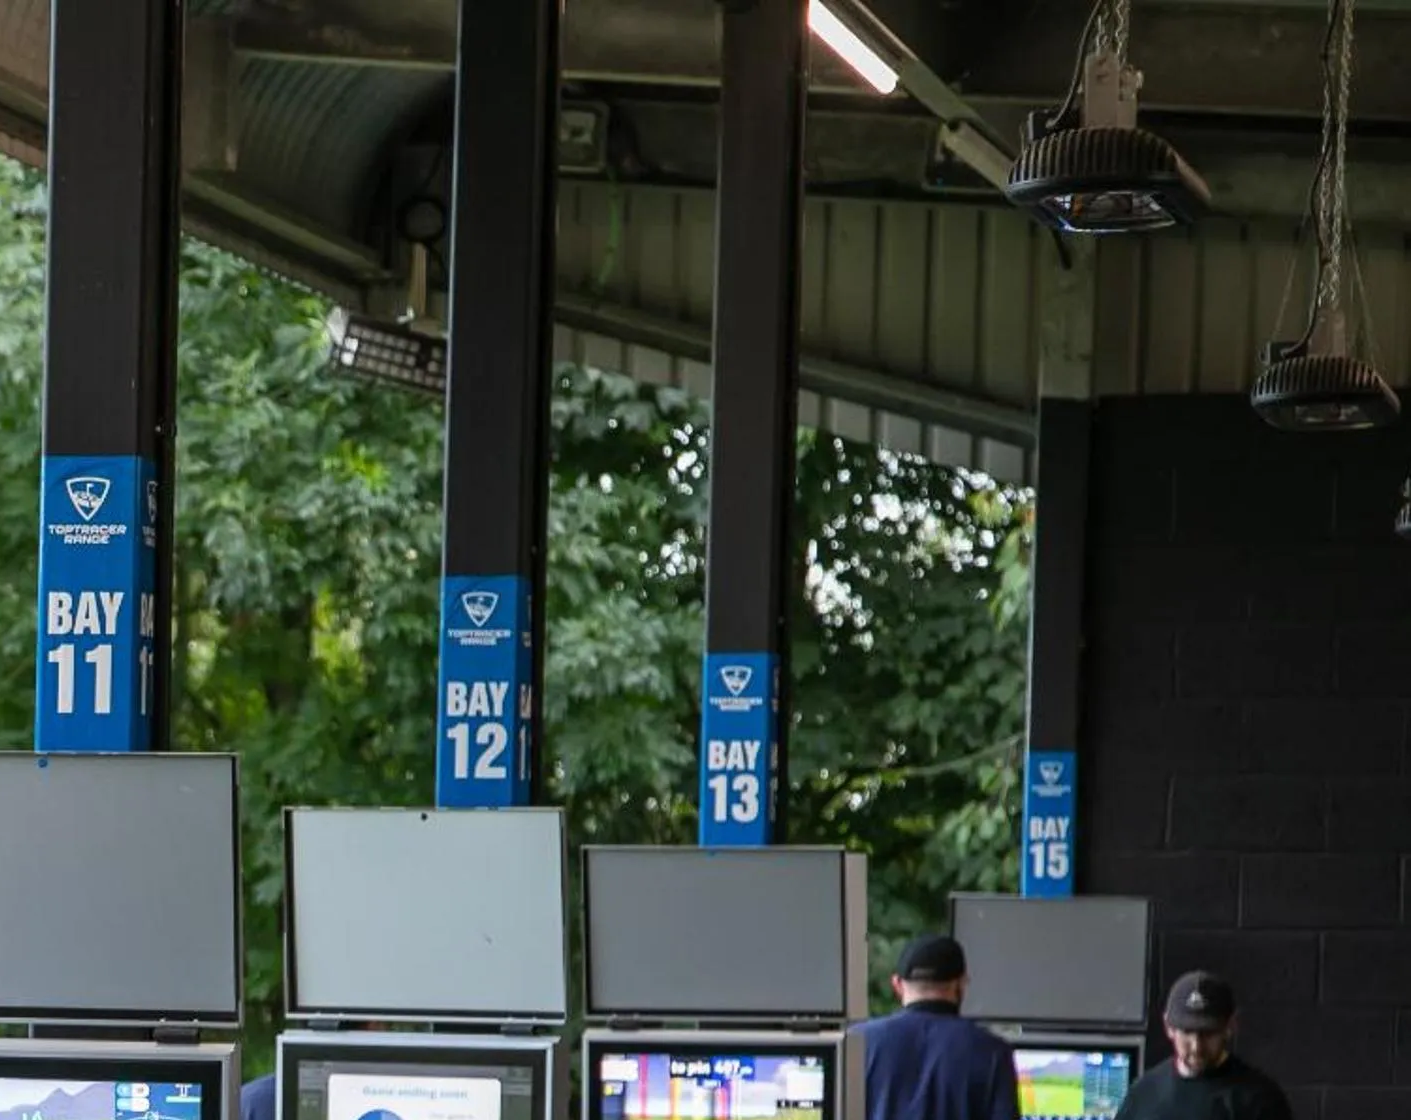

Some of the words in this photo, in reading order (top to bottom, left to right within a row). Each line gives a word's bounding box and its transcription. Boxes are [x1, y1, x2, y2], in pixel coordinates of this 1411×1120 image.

[48, 524, 127, 535] TOPTRACER
[64, 534, 110, 544] RANGE
[47, 592, 124, 635] BAY
[47, 644, 114, 715] 11
[446, 681, 509, 717] BAY
[446, 722, 508, 780] 12
[708, 740, 760, 771] BAY
[708, 774, 759, 823] 13
[1030, 816, 1069, 840] BAY
[1029, 842, 1069, 879] 15
